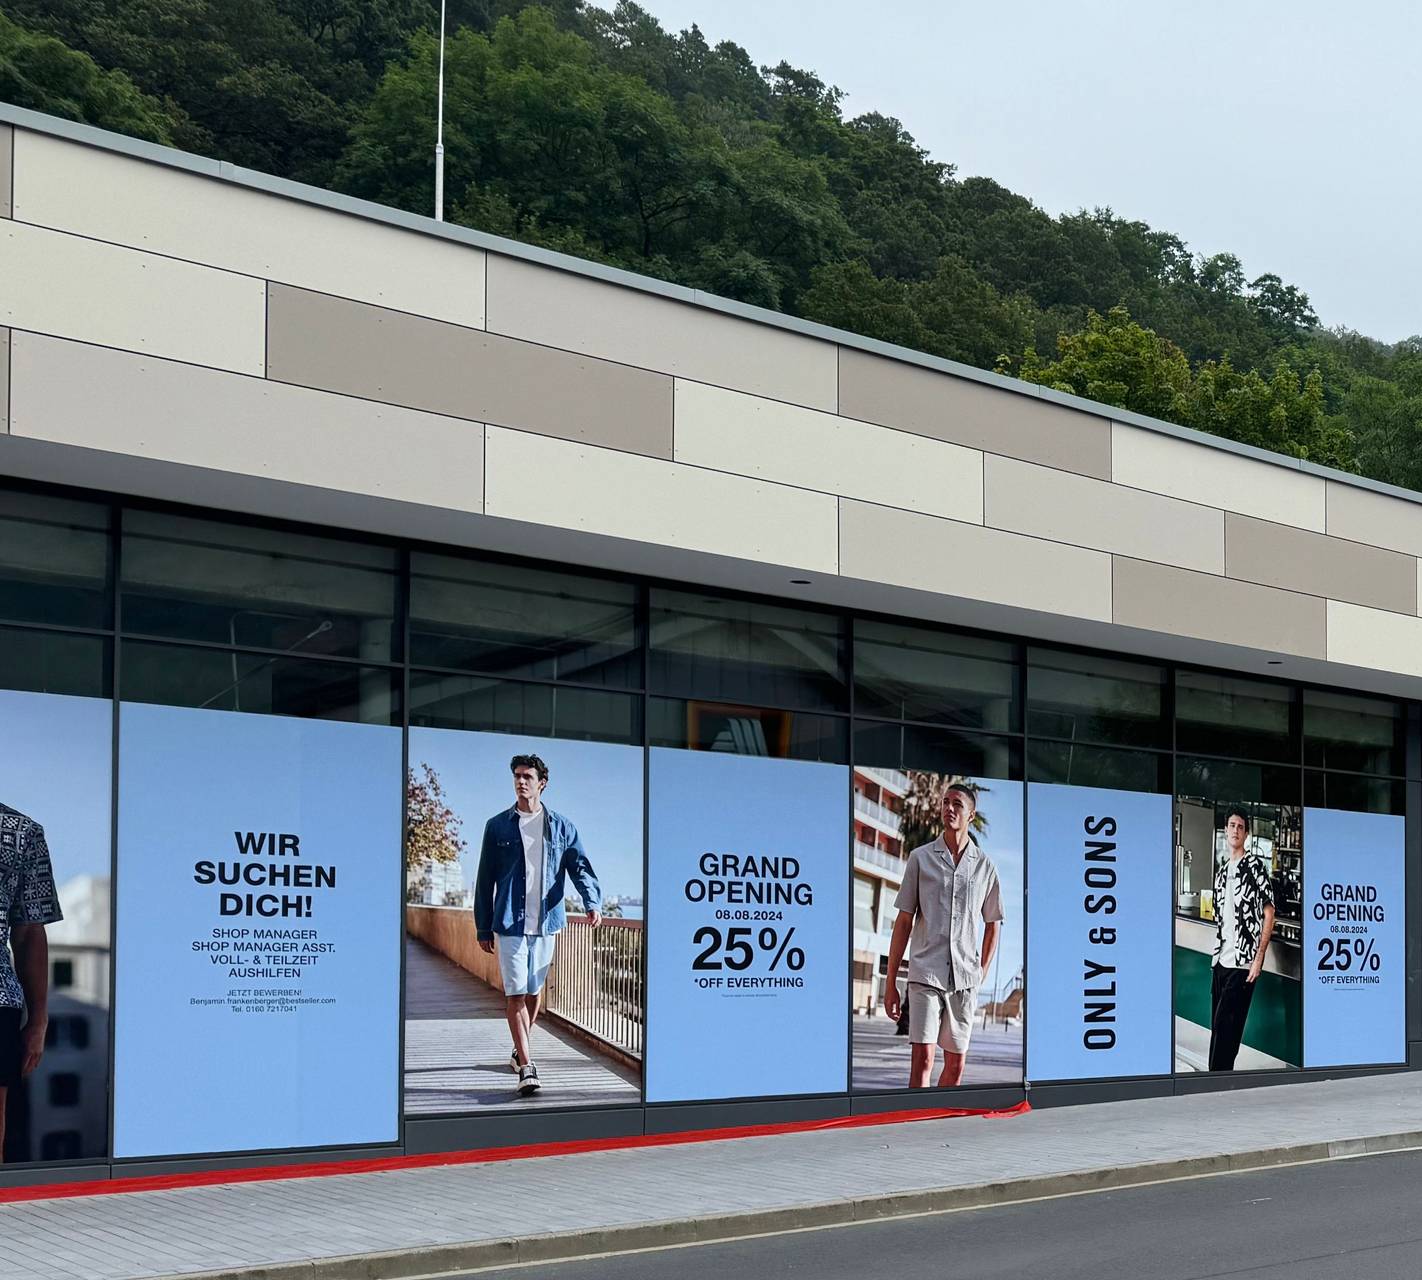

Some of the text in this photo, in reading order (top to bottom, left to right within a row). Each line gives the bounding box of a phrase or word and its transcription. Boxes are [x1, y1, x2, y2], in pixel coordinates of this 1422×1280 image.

[234, 831, 300, 857] WIR
[699, 853, 800, 880] GRAND
[194, 861, 336, 888] SUCHEN
[684, 878, 814, 906] OPENING
[1321, 883, 1377, 903] GRAND
[220, 893, 312, 918] DICH!
[1313, 903, 1385, 922] OPENING
[715, 909, 783, 921] 08.08.2024
[212, 928, 318, 940] SHOP MANAGER
[1083, 815, 1117, 1050] ONLY & SONS
[1330, 925, 1368, 934] 08.08.2024
[191, 941, 336, 953] SHOP MANAGER ASST.
[691, 926, 805, 972] 25%
[210, 955, 319, 965] VOLL- & TEILZEIT
[1318, 938, 1381, 972] 25%
[228, 968, 301, 978] AUSHILFEN
[1336, 975, 1380, 984] EVERYTHING
[727, 977, 804, 988] EVERYTHING
[253, 989, 302, 997] BEWERBEN!
[231, 1005, 243, 1013] Tel.
[246, 1005, 265, 1013] 0160
